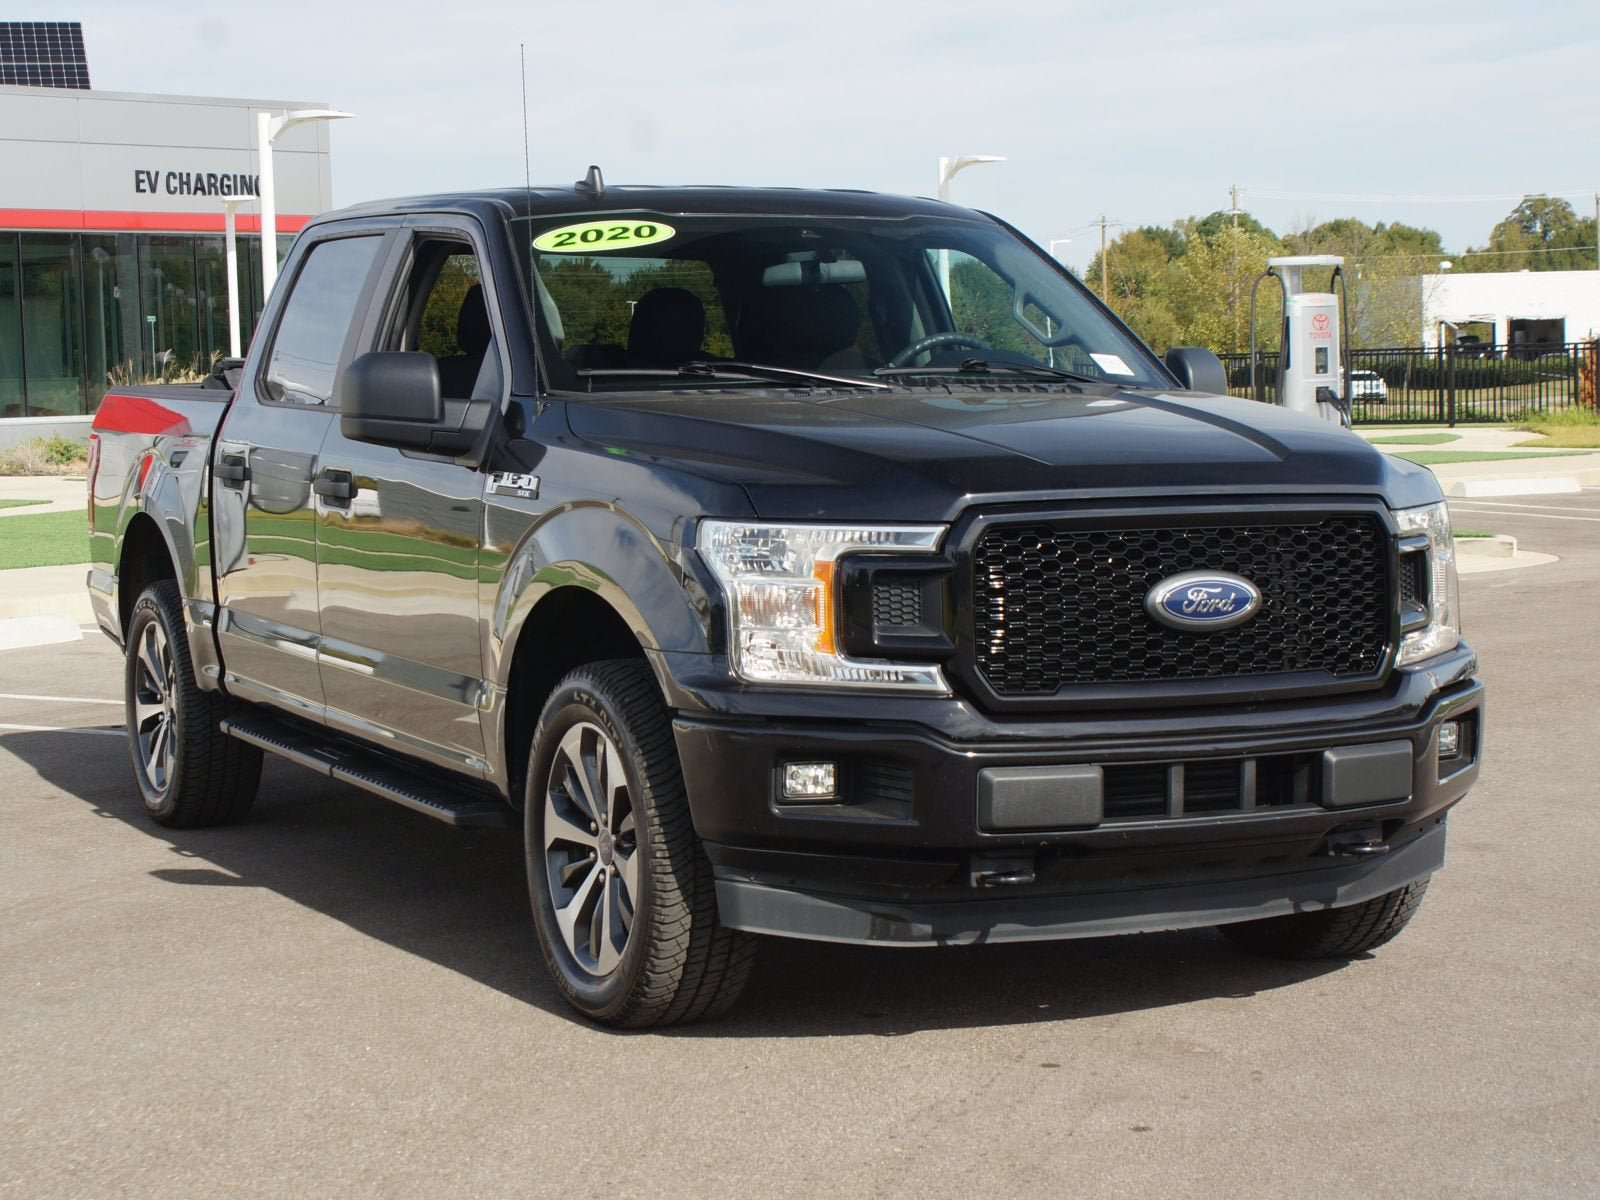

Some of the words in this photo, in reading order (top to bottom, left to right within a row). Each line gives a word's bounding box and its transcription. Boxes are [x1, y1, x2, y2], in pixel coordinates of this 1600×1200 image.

[134, 169, 160, 194] EV
[552, 225, 657, 248] 2020
[1182, 587, 1236, 613] Ford
